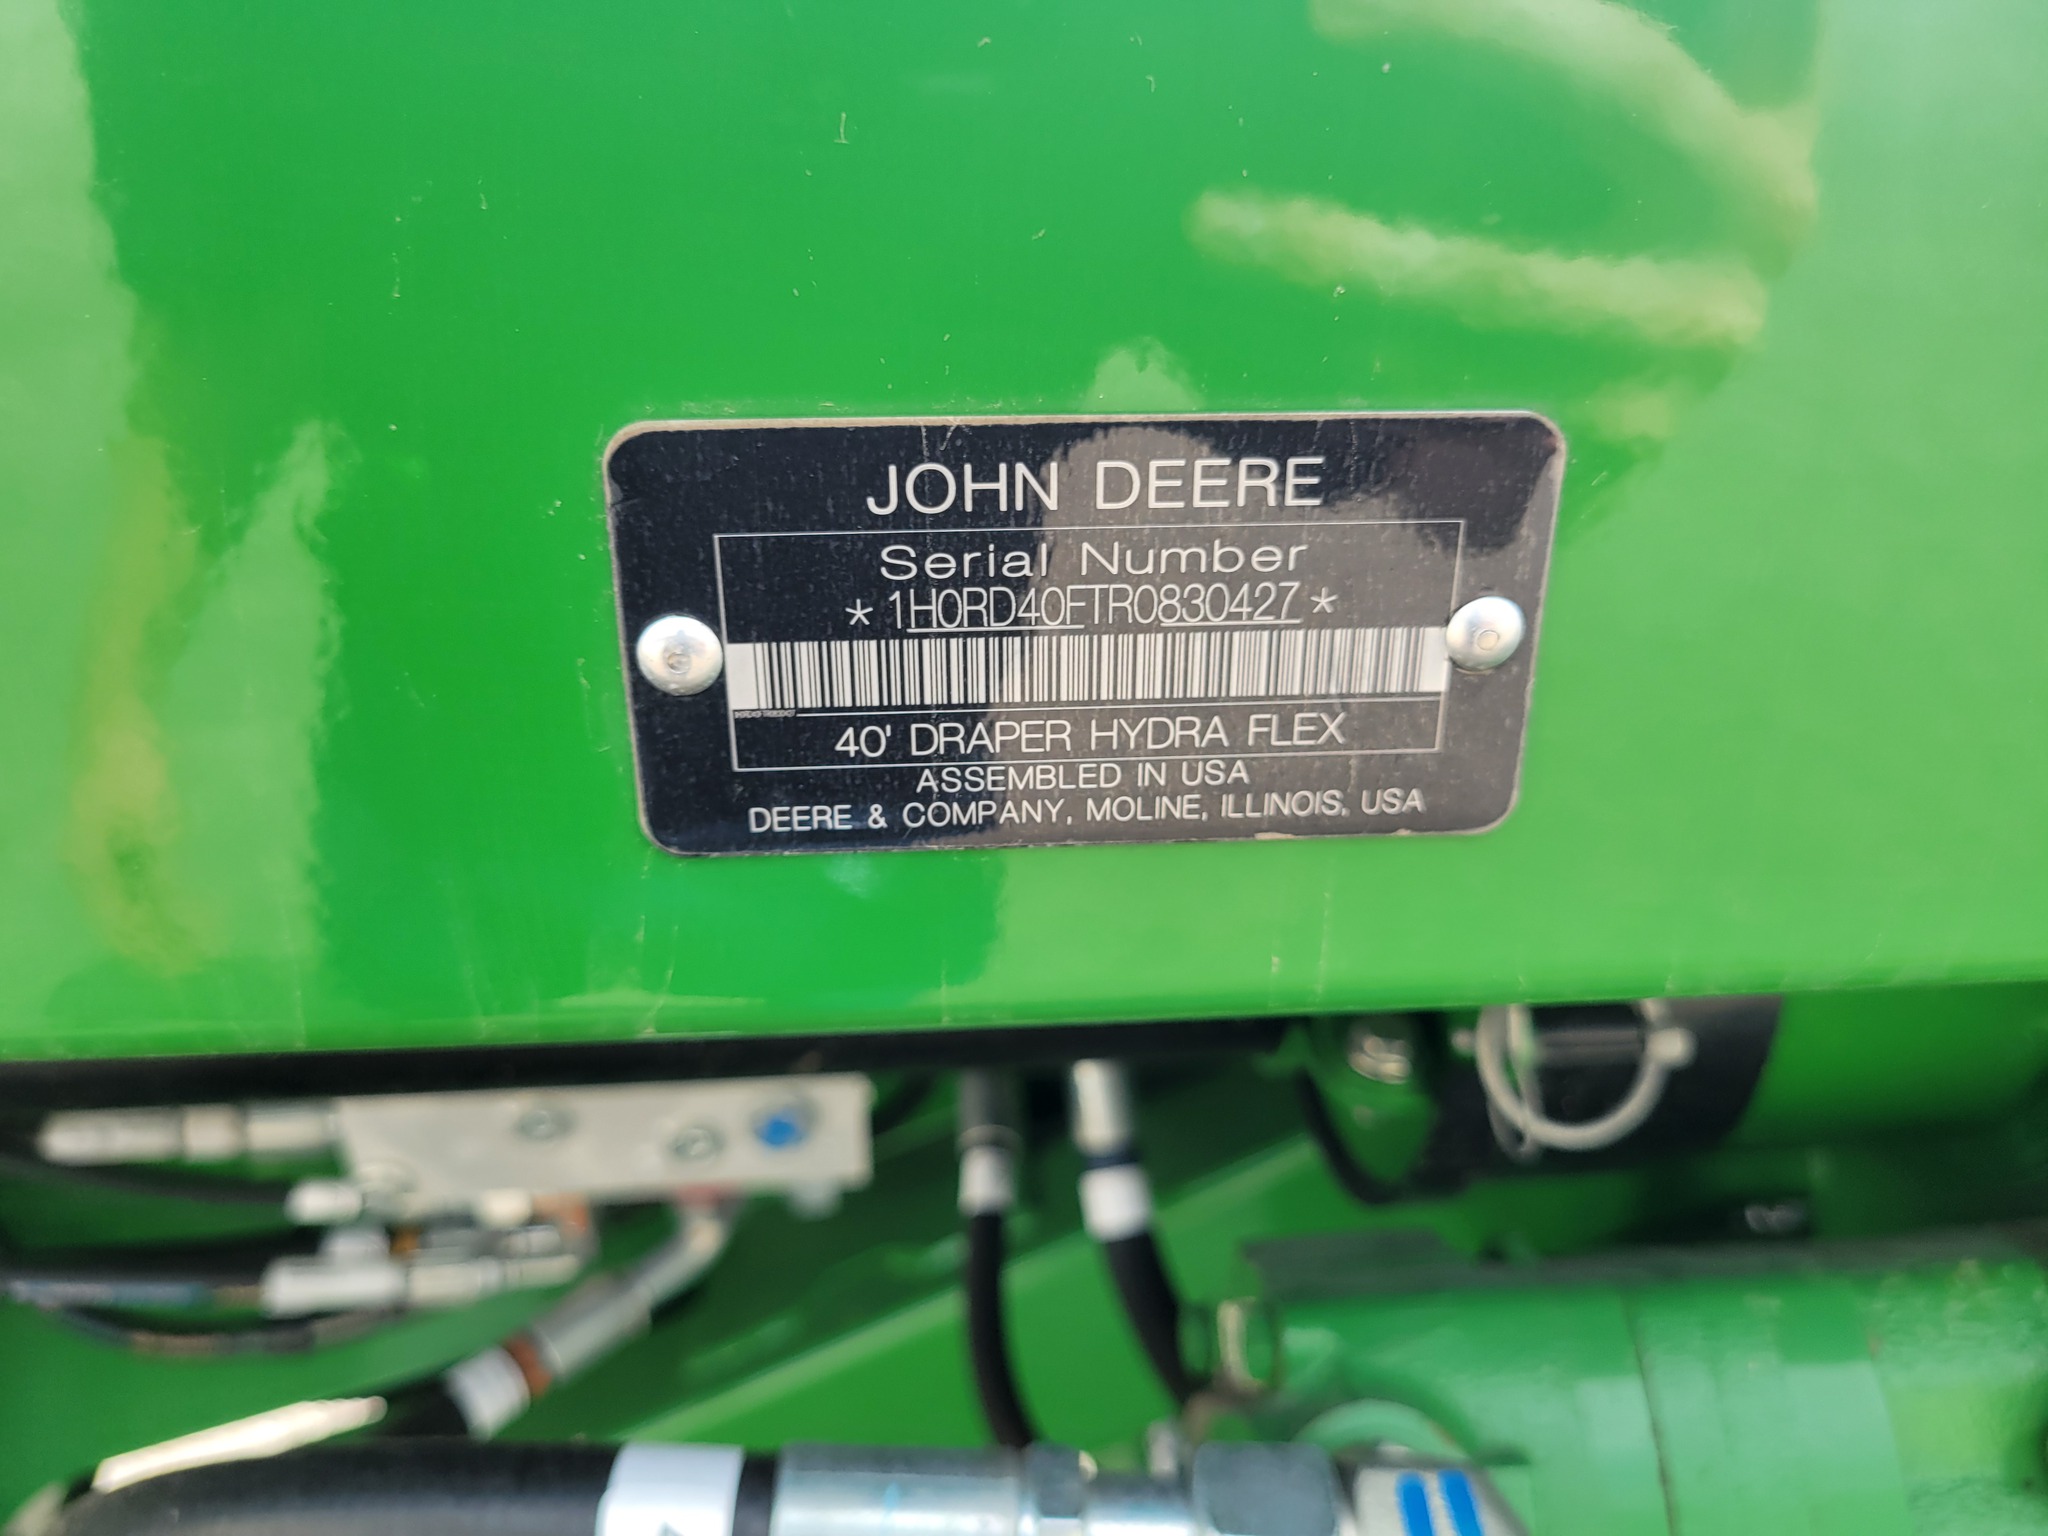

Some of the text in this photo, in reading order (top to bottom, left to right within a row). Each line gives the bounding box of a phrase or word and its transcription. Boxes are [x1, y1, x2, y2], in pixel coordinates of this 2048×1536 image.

[866, 456, 1326, 515] JOHN DEERE
[880, 539, 1309, 580] Serial Number
[834, 712, 1347, 757] 40' DRAPER HYDRA FLEX
[916, 760, 1250, 793] ASSEMBLED IN USA
[749, 805, 852, 834] DEERE
[867, 804, 888, 829] &
[903, 798, 1073, 828] COMPANY,
[1086, 795, 1209, 822] MOLINE,
[1361, 788, 1427, 814] USA
